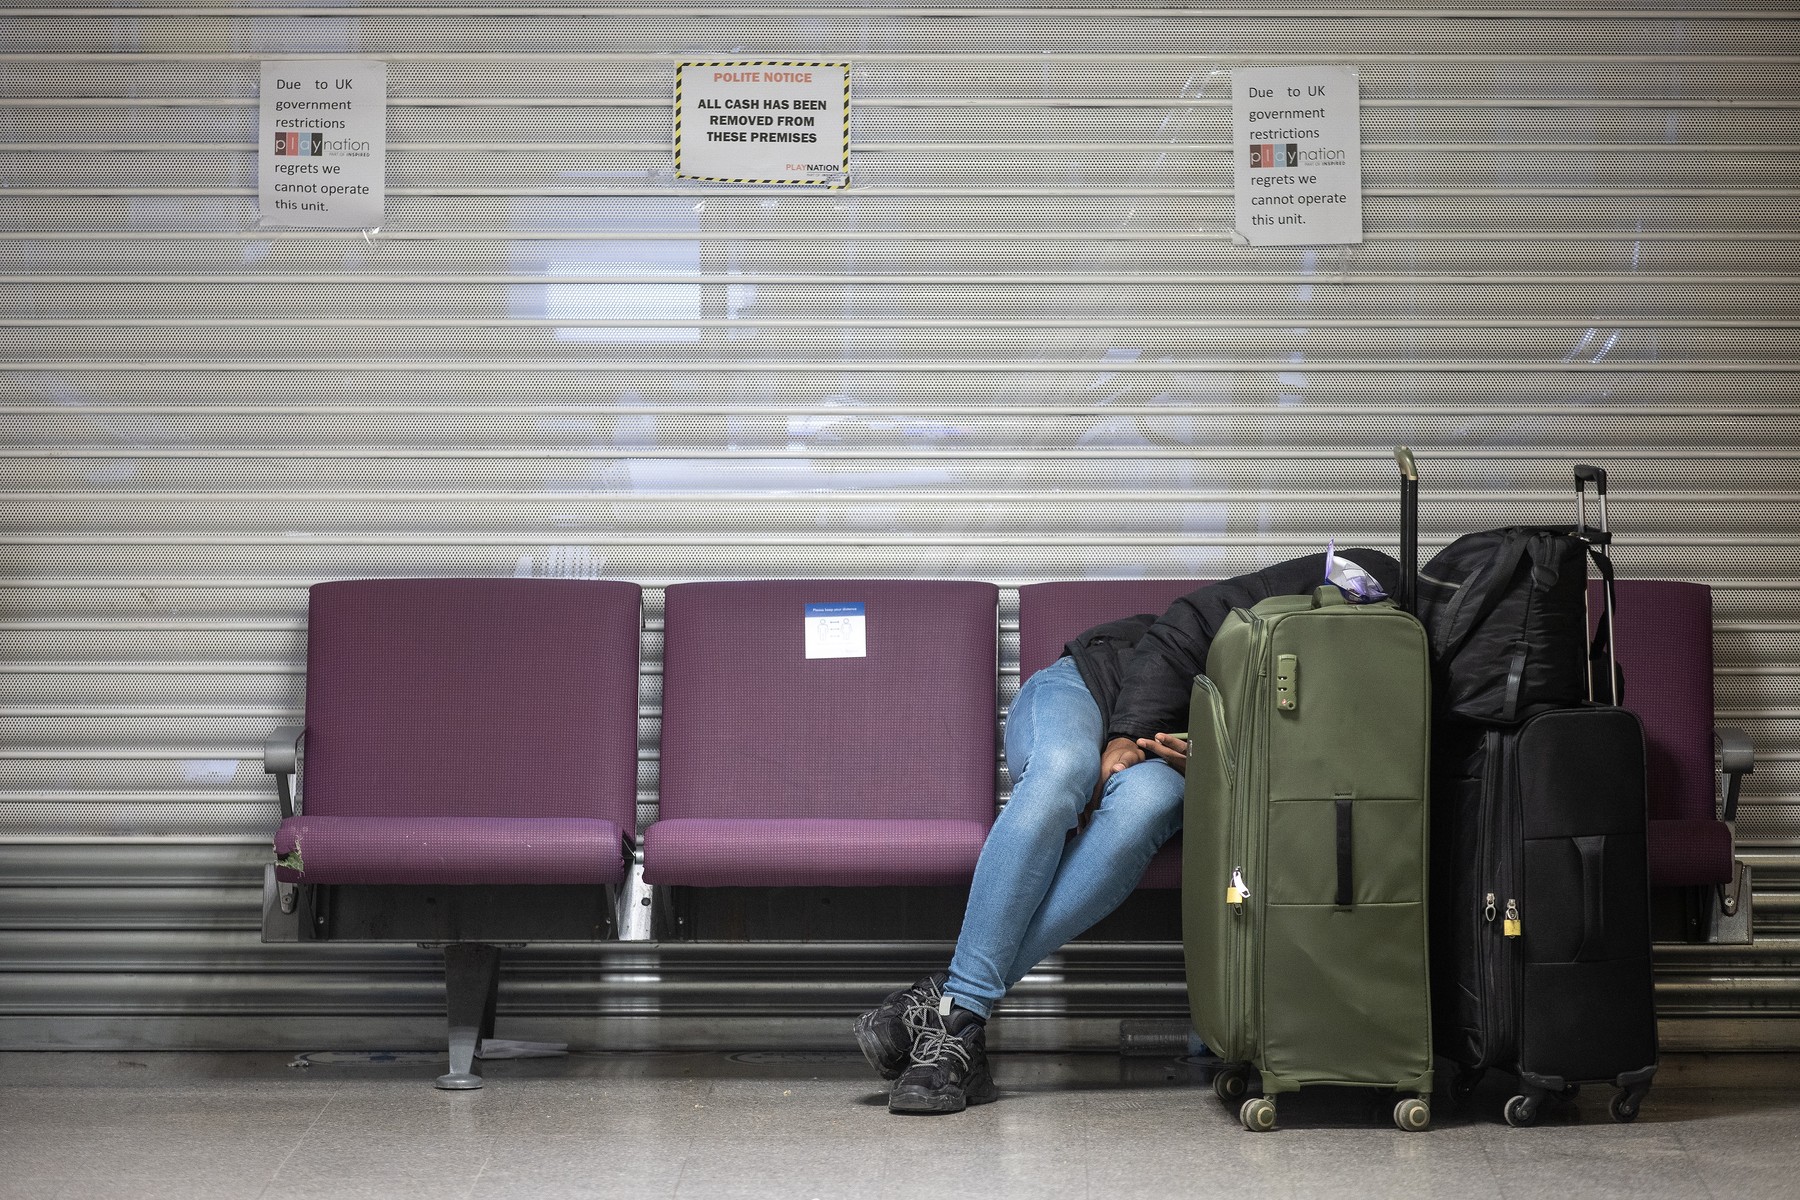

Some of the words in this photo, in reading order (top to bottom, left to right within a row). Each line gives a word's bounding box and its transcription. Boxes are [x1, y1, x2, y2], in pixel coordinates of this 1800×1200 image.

[714, 73, 760, 82] POLITE
[764, 73, 812, 82] NOTICE
[277, 79, 301, 89] Due
[315, 80, 328, 89] to
[335, 79, 353, 89] UK
[1249, 87, 1273, 97] Due
[1288, 87, 1300, 97] to
[1308, 86, 1325, 97] UK
[276, 101, 351, 111] government
[698, 100, 721, 109] ALL
[725, 100, 759, 109] CASH
[763, 100, 789, 110] HAS
[793, 101, 827, 110] BEEN
[1249, 108, 1325, 122] government
[276, 118, 345, 128] restrictions
[710, 116, 773, 126] REMOVED
[778, 117, 814, 126] FROM
[707, 132, 747, 142] THESE
[751, 133, 817, 143] PREMISES
[1250, 128, 1319, 139] restrictions
[275, 164, 318, 175] regrets
[322, 166, 340, 174] we
[1251, 175, 1295, 187] regrets
[1298, 175, 1317, 184] we
[275, 183, 317, 193] cannot
[321, 185, 369, 196] operate
[1251, 194, 1293, 205] cannot
[1298, 193, 1346, 206] operate
[275, 200, 297, 209] this
[301, 201, 328, 211] unit.
[1252, 214, 1274, 225] this
[1278, 214, 1306, 225] unit.
